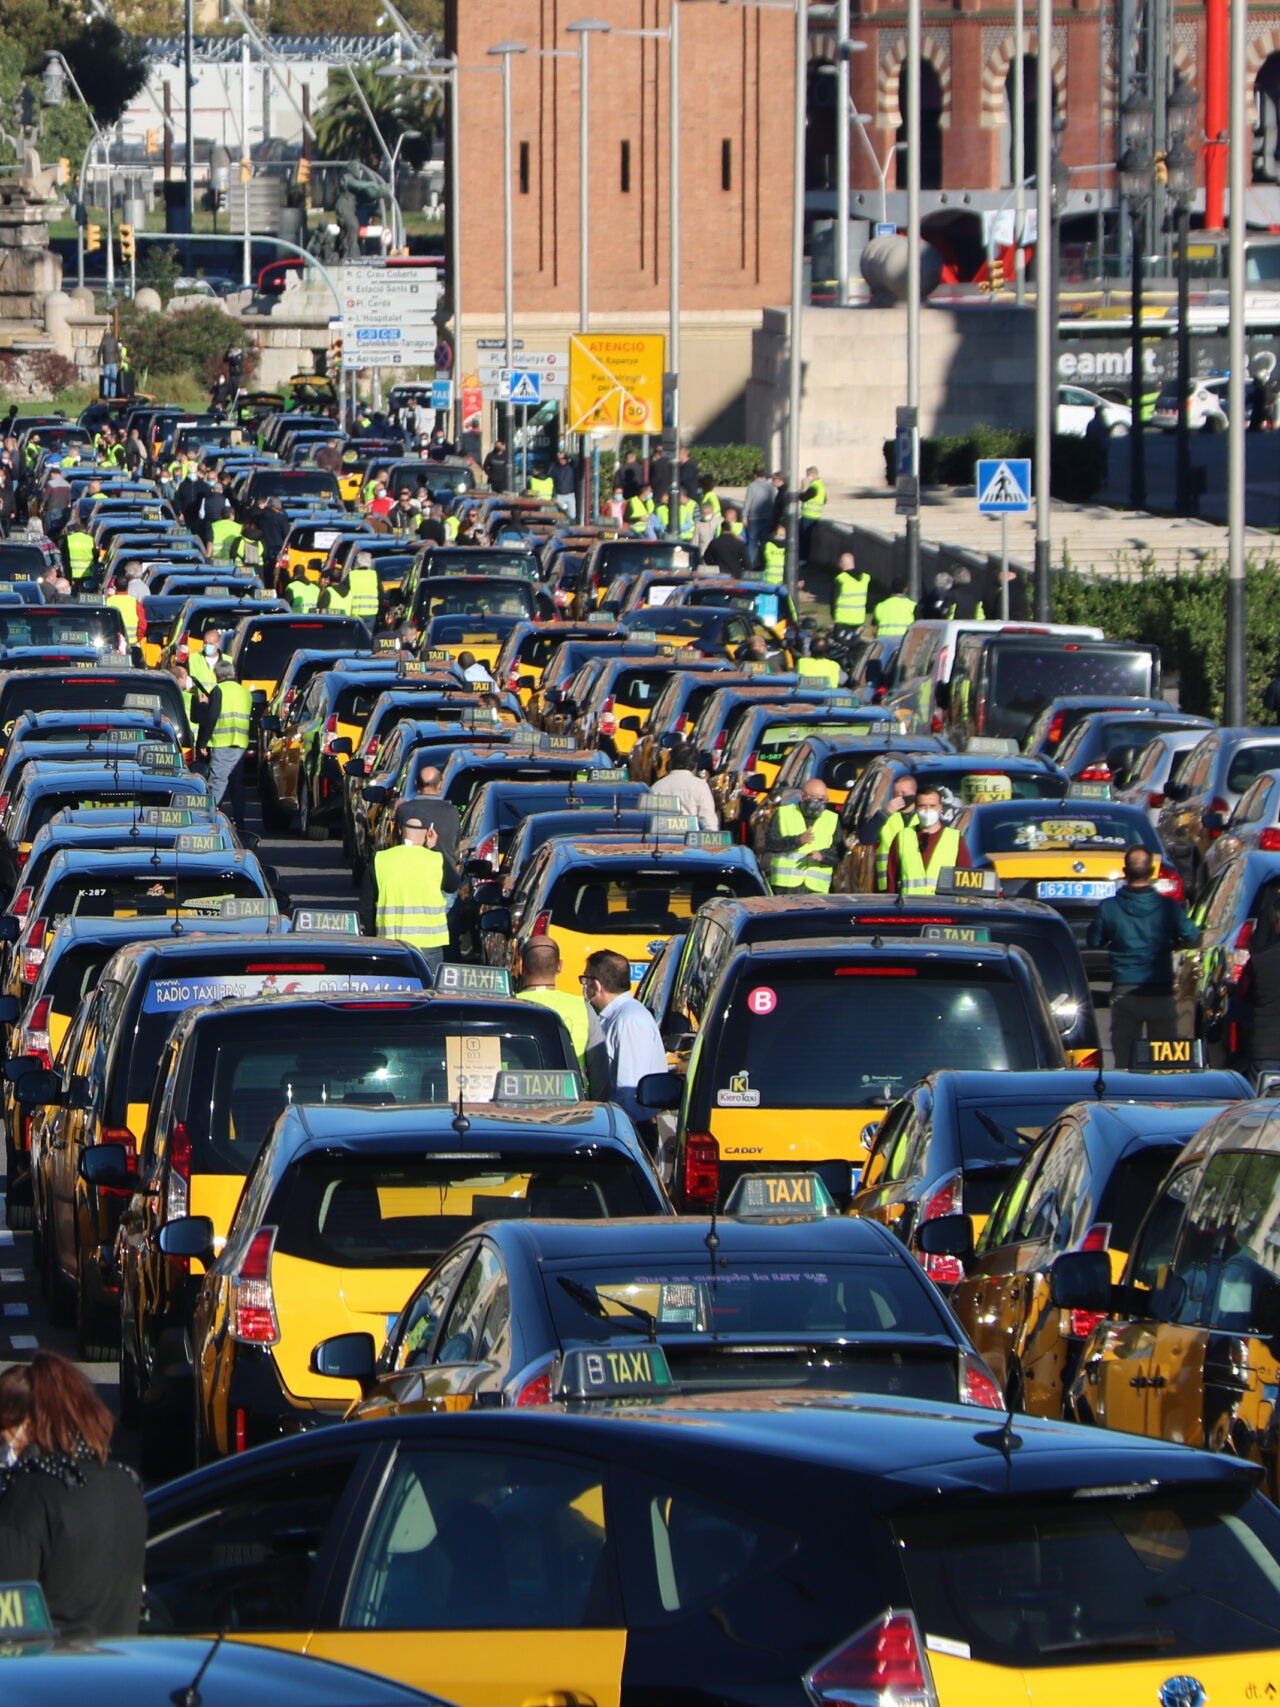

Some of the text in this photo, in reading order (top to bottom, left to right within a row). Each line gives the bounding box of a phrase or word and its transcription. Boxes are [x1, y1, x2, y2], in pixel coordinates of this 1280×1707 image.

[589, 341, 646, 352] ATENCIÓ
[628, 406, 643, 416] 30
[379, 638, 396, 648] TAXI
[428, 651, 445, 661] TAXI
[404, 661, 420, 673] TAXI
[472, 682, 489, 691] TAXI
[120, 731, 137, 741] TAXI
[549, 737, 567, 748] TAXI
[156, 753, 174, 765] TAXI
[187, 796, 207, 807] TAXI
[161, 811, 182, 823] TAXI
[667, 818, 688, 830] TAXI
[192, 836, 214, 849] TAXI
[700, 833, 720, 845] TAXI
[955, 870, 983, 889] TAXI
[78, 889, 107, 897] K-287
[1047, 884, 1083, 896] 6219
[241, 901, 269, 916] TAXI
[313, 911, 348, 930] TAXI
[943, 928, 976, 942] TAXI
[458, 966, 496, 990] TAXI
[156, 983, 247, 1004] RADIO TAXI PRAT
[754, 991, 772, 1012] B
[1150, 1040, 1191, 1063] TAXI
[523, 1074, 560, 1096] TAXI
[733, 1077, 746, 1092] K
[720, 1093, 757, 1103] KieroTaxi
[725, 1147, 764, 1155] CADDY
[765, 1178, 812, 1204] TAXI
[606, 1352, 652, 1385] TAXI
